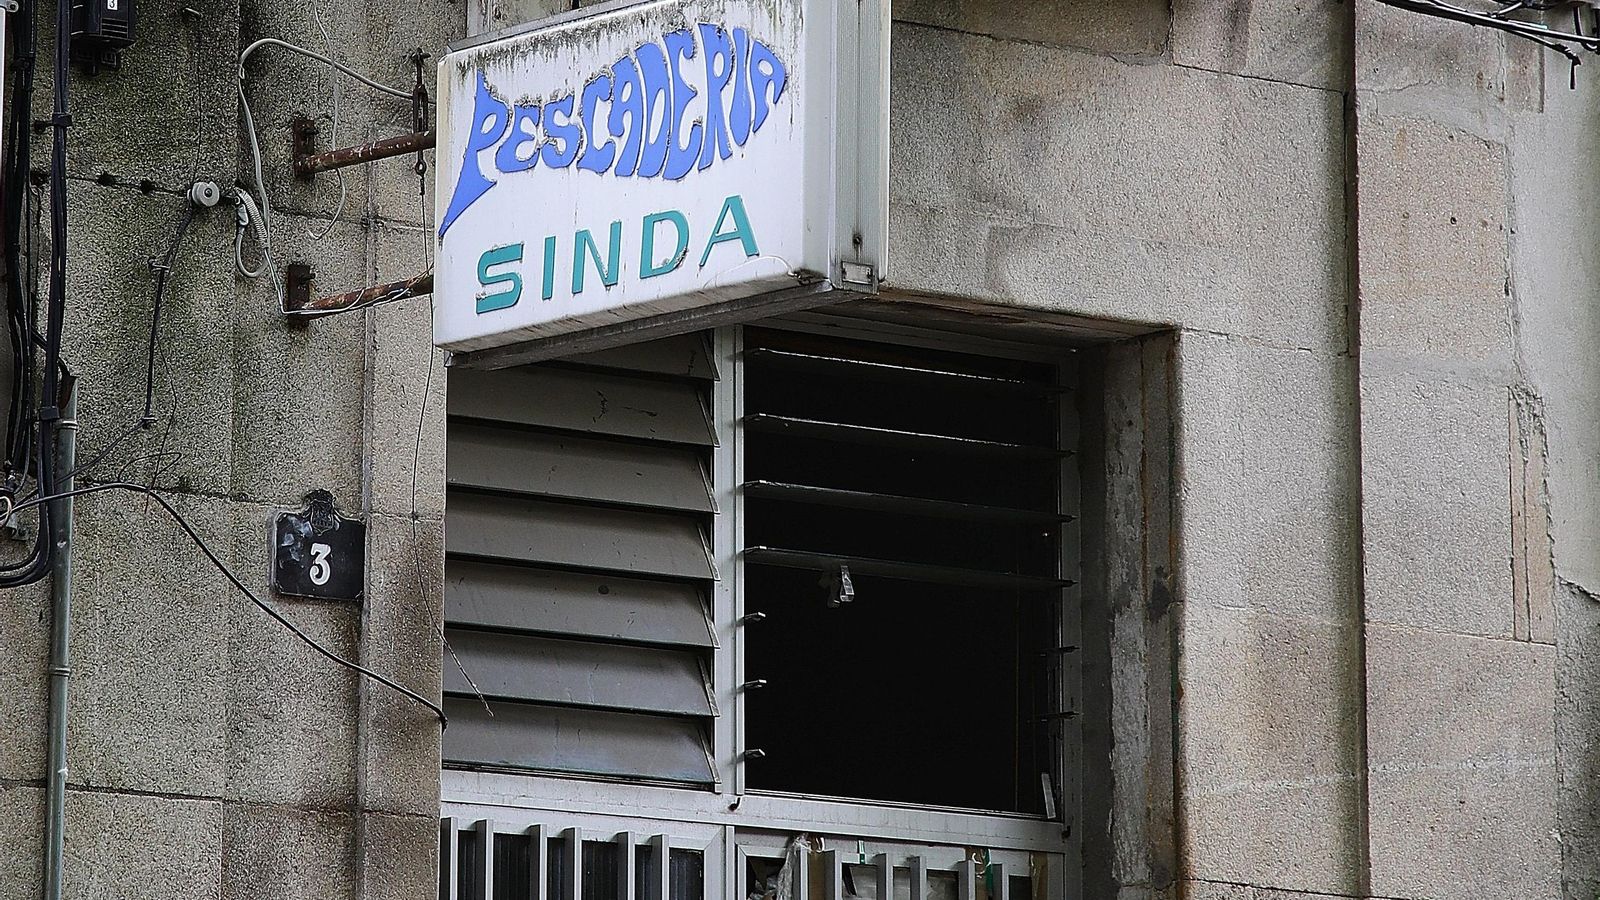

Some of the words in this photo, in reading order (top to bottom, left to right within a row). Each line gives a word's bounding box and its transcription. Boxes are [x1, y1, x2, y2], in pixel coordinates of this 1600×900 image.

[438, 23, 787, 238] PESCADERIA
[476, 195, 760, 314] SINDA
[309, 542, 331, 586] 3
